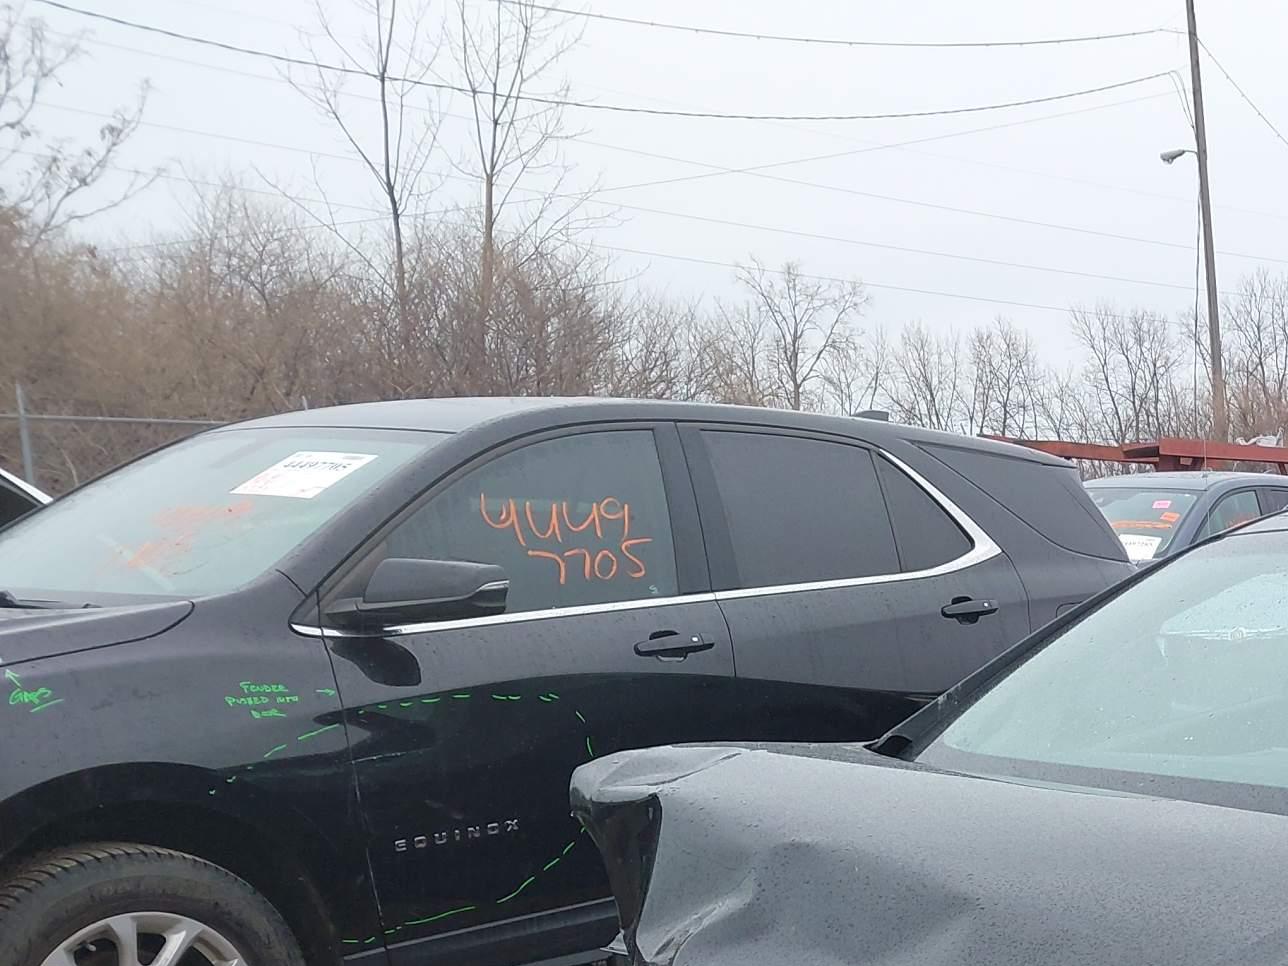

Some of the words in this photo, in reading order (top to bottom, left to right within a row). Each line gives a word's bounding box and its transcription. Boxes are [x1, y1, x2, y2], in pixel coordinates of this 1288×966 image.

[480, 492, 630, 547] 4449
[527, 537, 653, 585] 7705
[394, 819, 520, 852] EQUINOX
